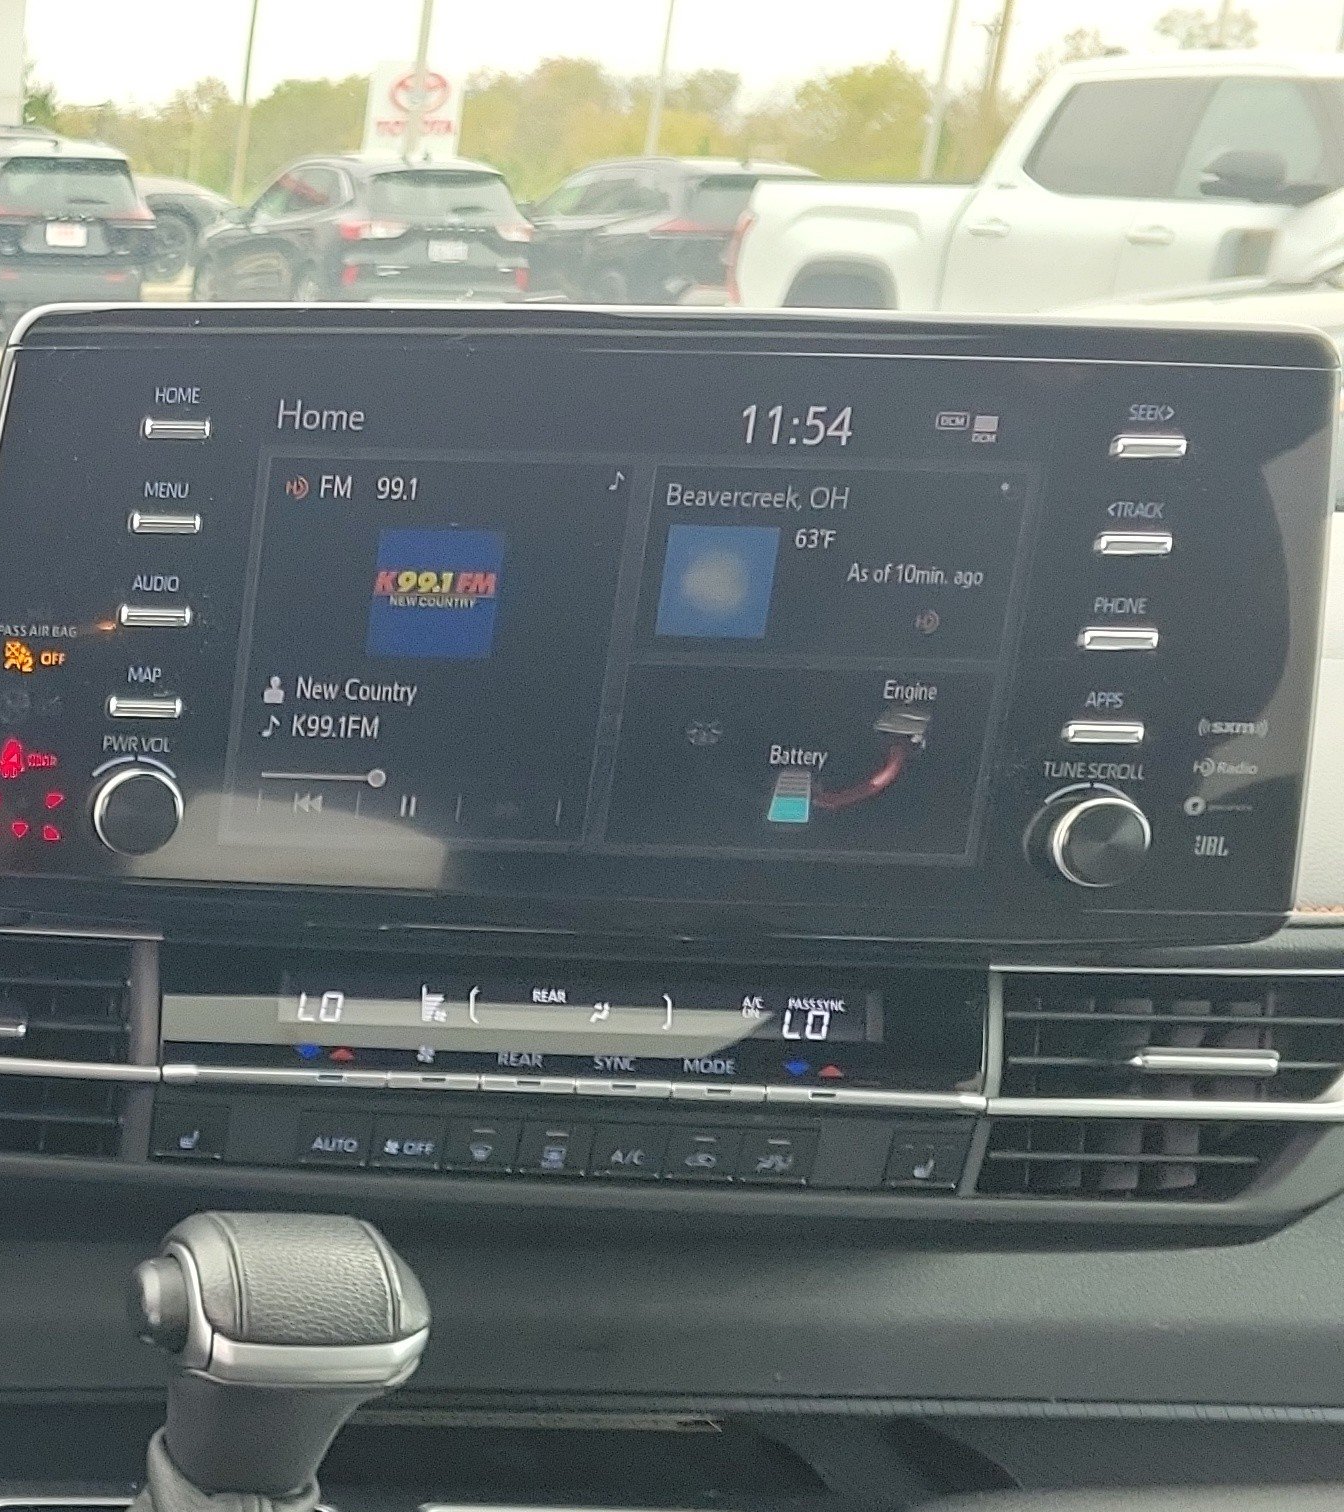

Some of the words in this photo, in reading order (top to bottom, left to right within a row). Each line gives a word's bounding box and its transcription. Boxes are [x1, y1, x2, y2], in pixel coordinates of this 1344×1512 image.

[155, 387, 200, 404] HOME
[277, 399, 365, 432] Home
[741, 405, 854, 447] 11:54
[144, 481, 189, 499] MENU
[320, 476, 352, 499] FM
[376, 477, 419, 500] 99.1
[667, 483, 801, 511] Beavercreek,
[809, 486, 849, 511] OH
[132, 574, 179, 592] AUDIO
[847, 563, 869, 583] As
[872, 563, 893, 584] of
[895, 564, 949, 586] 10min.
[953, 568, 984, 588] ago
[1094, 597, 1147, 615] PHONE
[29, 624, 50, 637] AIR
[51, 626, 77, 638] BAG
[40, 652, 65, 665] OFF
[127, 666, 161, 683] MAP
[296, 678, 338, 701] New
[344, 678, 417, 706] Country
[883, 680, 938, 703] Engine
[1085, 691, 1123, 709] APPS
[291, 715, 380, 740] K99.1FM
[103, 735, 138, 752] PWR
[141, 737, 172, 753] VOL
[769, 746, 828, 771] Battery
[1043, 760, 1087, 779] TUNE
[1089, 760, 1145, 782] SCROLL
[1194, 835, 1229, 857] JBL
[532, 987, 566, 1003] REAR
[297, 990, 345, 1022] LO
[782, 1009, 830, 1040] LO
[498, 1052, 544, 1068] REAR
[593, 1056, 636, 1072] SYNC
[683, 1059, 736, 1075] MODE
[312, 1137, 357, 1154] AUTO
[403, 1142, 434, 1156] OFF
[611, 1150, 644, 1166] A/C
